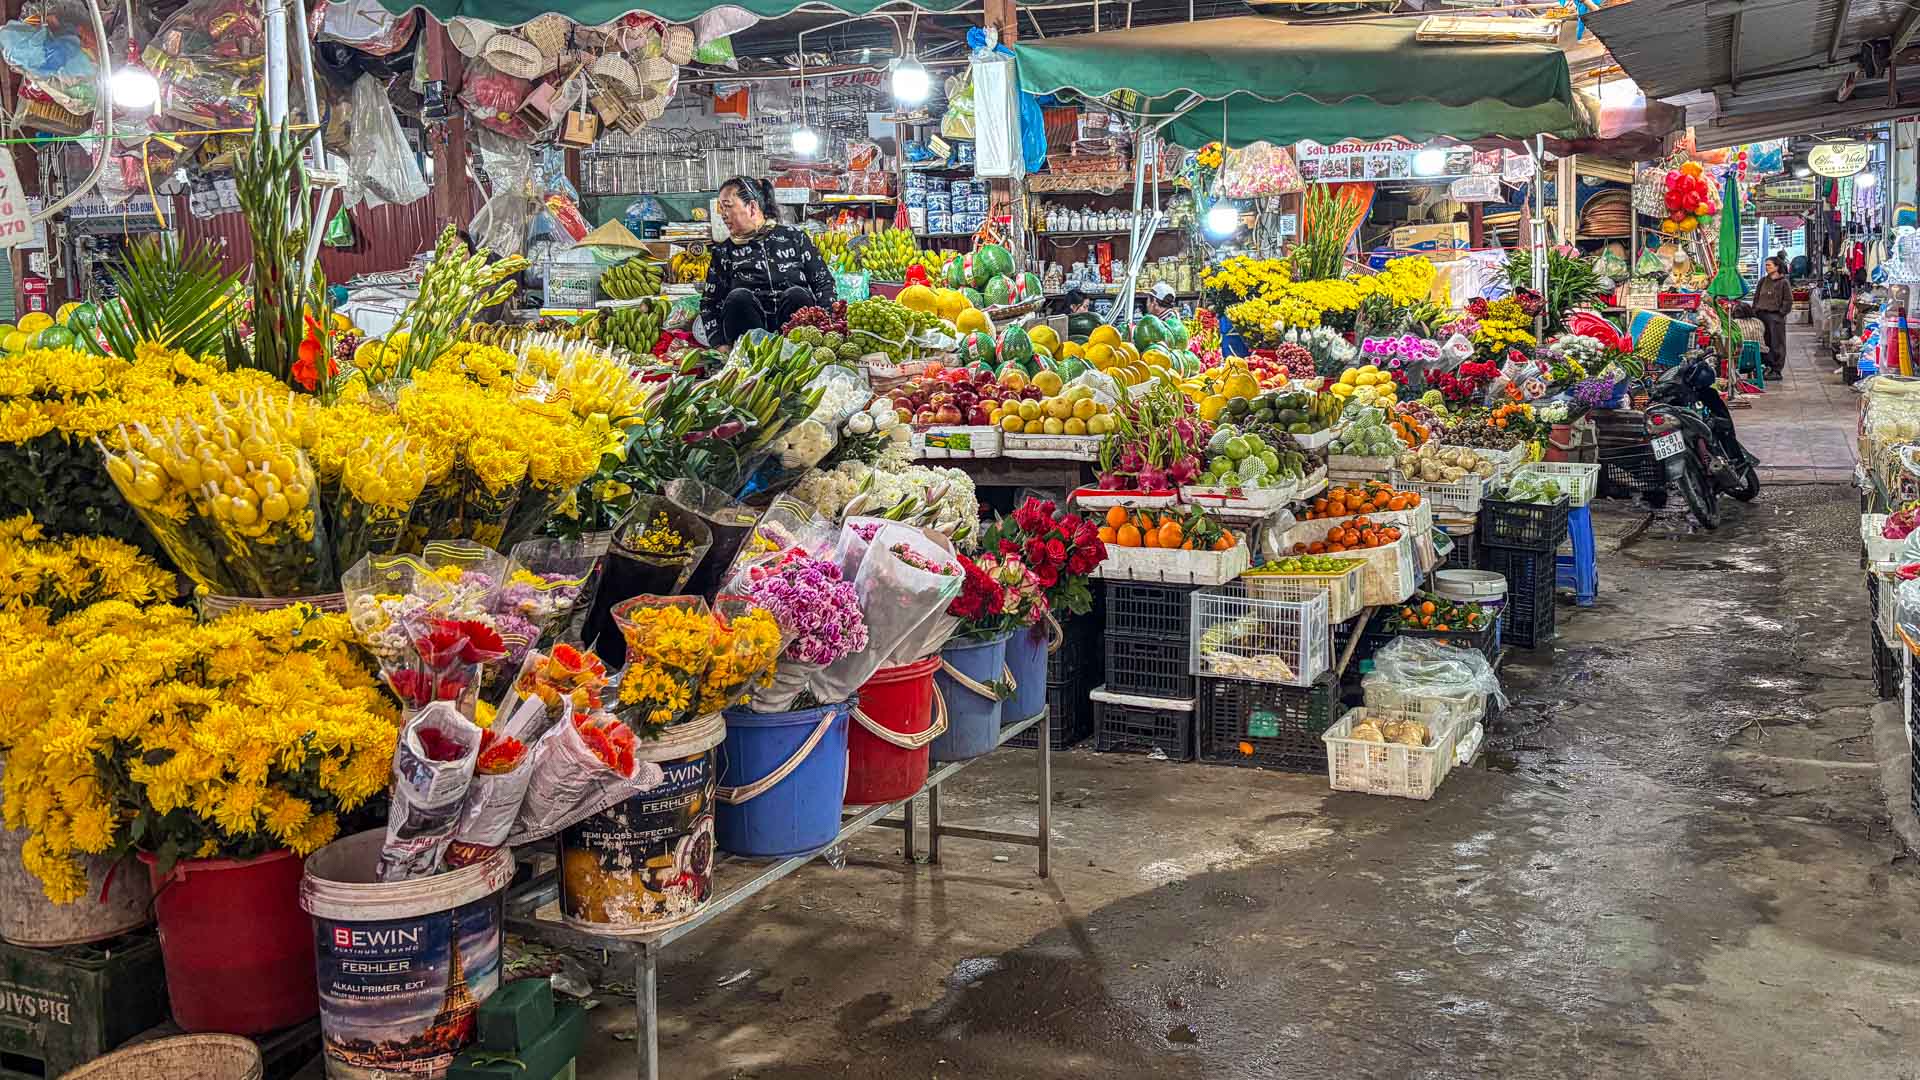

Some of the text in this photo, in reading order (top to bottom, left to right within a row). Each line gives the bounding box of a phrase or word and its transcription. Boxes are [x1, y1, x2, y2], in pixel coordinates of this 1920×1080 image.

[642, 793, 698, 813] FERHLER
[335, 927, 418, 947] BEWIN
[334, 947, 378, 955] PLATINUM
[342, 961, 410, 973] FERHLER
[332, 981, 360, 992] ALKALI
[405, 980, 426, 990] EXT
[39, 998, 72, 1025] Bia
